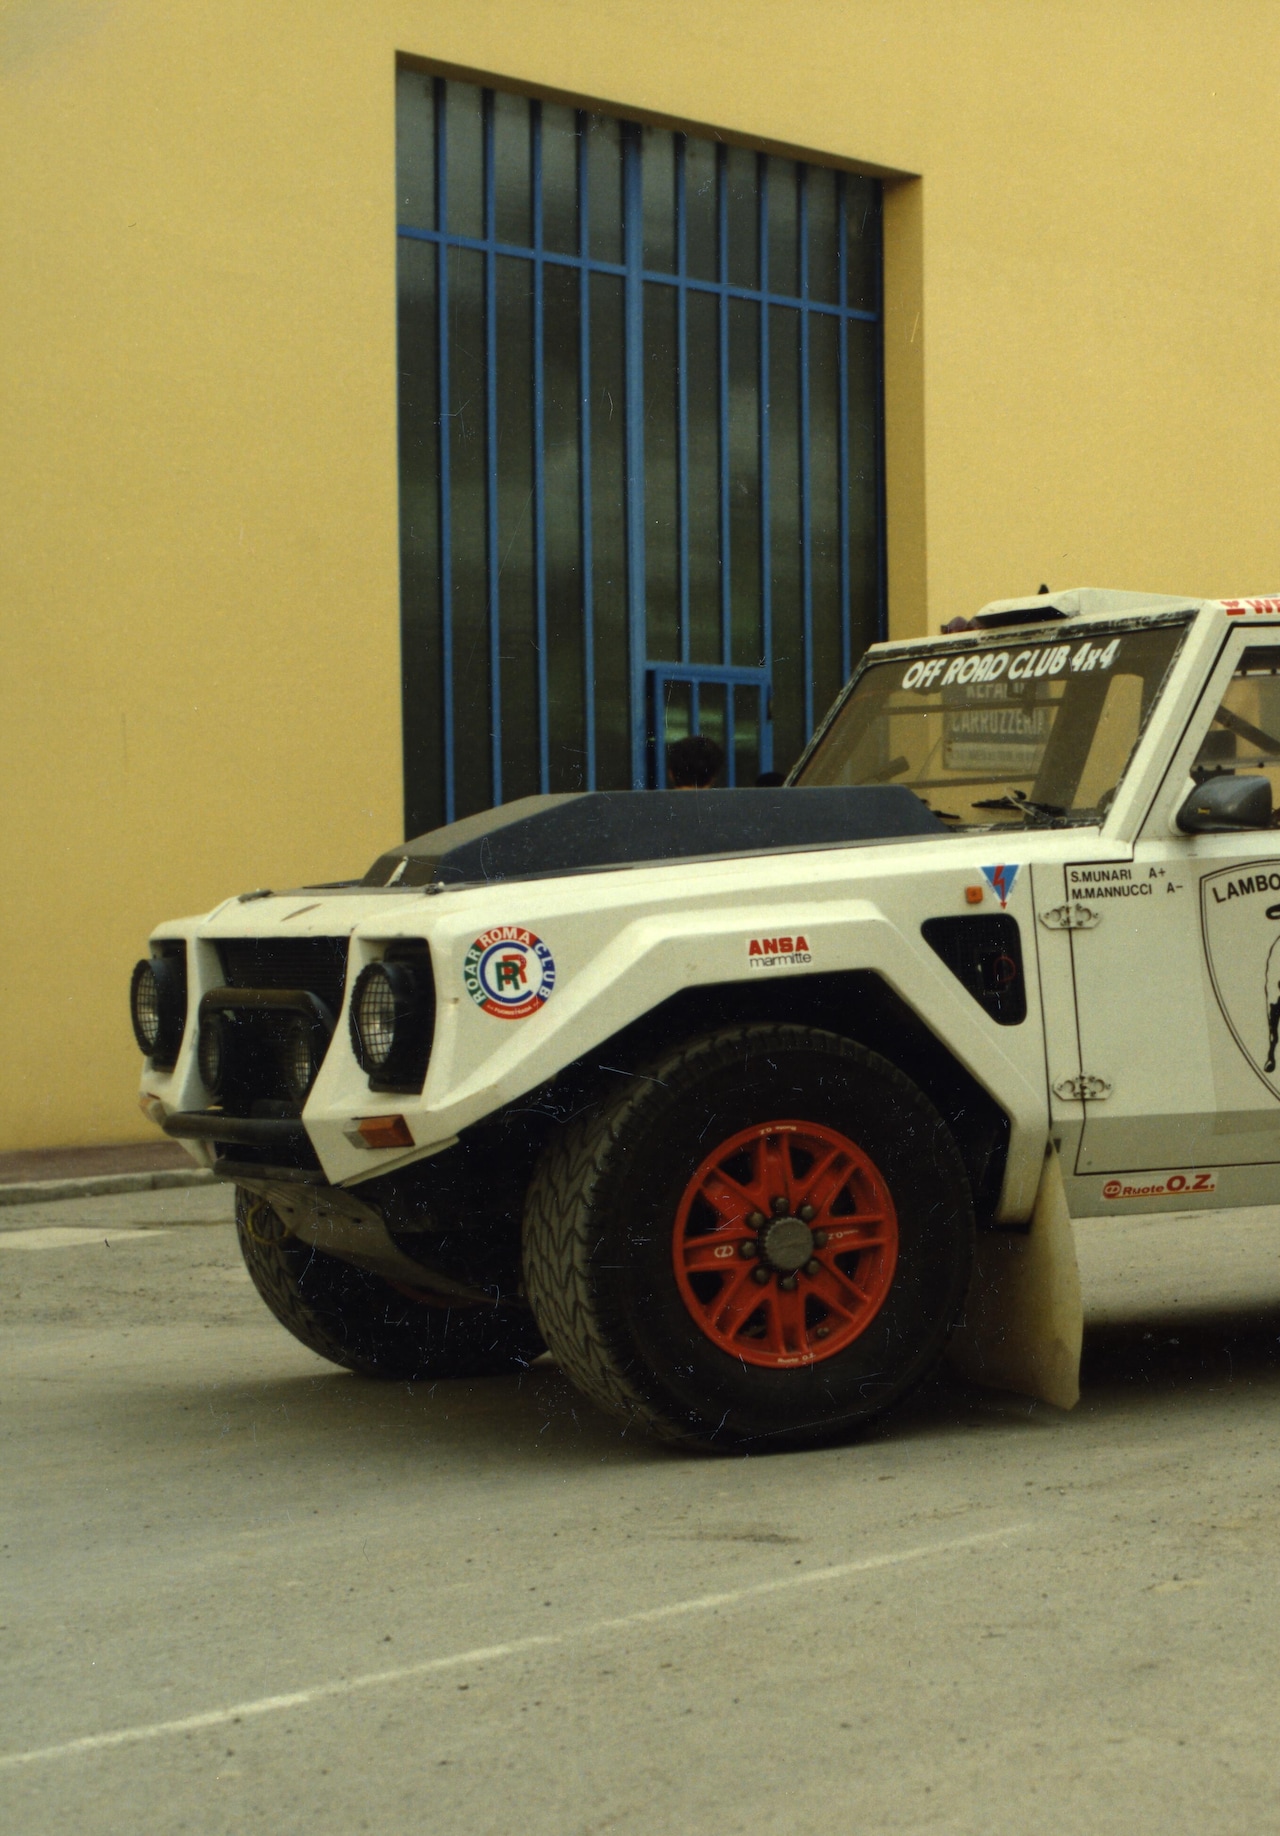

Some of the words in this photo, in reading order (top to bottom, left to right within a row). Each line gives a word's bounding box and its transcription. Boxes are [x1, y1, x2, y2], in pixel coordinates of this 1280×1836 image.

[902, 659, 947, 689] OFF
[941, 652, 1009, 685] ROAD
[1008, 645, 1071, 680] CLUB
[1070, 869, 1132, 882] S.MUNARI
[1071, 884, 1152, 900] M.MANNUCCI
[479, 926, 531, 948] ROMA
[748, 936, 810, 956] ANSA
[534, 942, 554, 998] CLUB
[749, 952, 812, 968] marmitte
[464, 948, 487, 1003] ROAR
[1122, 1185, 1164, 1196] Ruote
[1166, 1174, 1216, 1192] O.Z.
